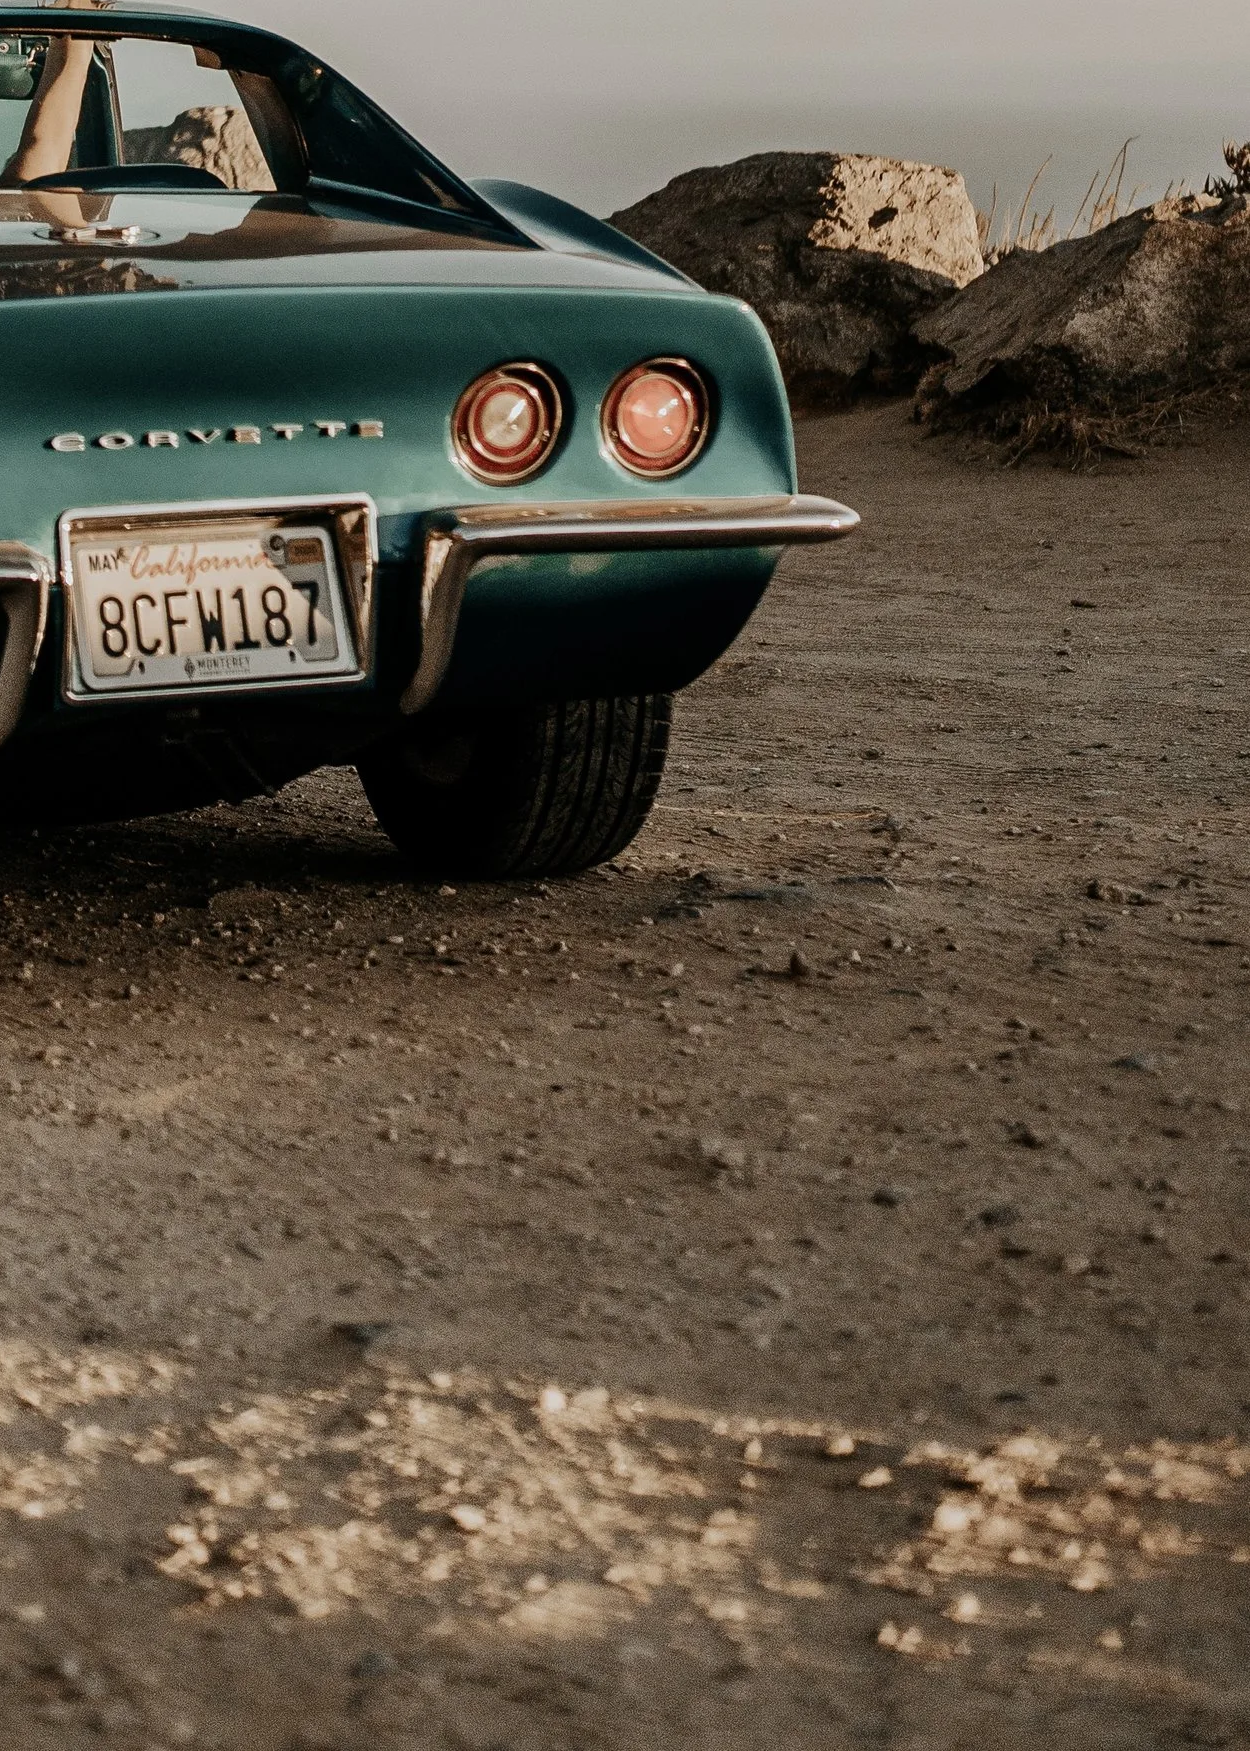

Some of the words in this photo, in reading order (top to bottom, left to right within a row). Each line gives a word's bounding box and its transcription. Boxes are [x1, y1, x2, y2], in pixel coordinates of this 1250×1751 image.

[50, 419, 384, 452] CORVETTE
[88, 551, 121, 572] MAY
[130, 543, 275, 585] California
[99, 580, 320, 658] 8CFW187
[197, 655, 251, 670] MONTEREY
